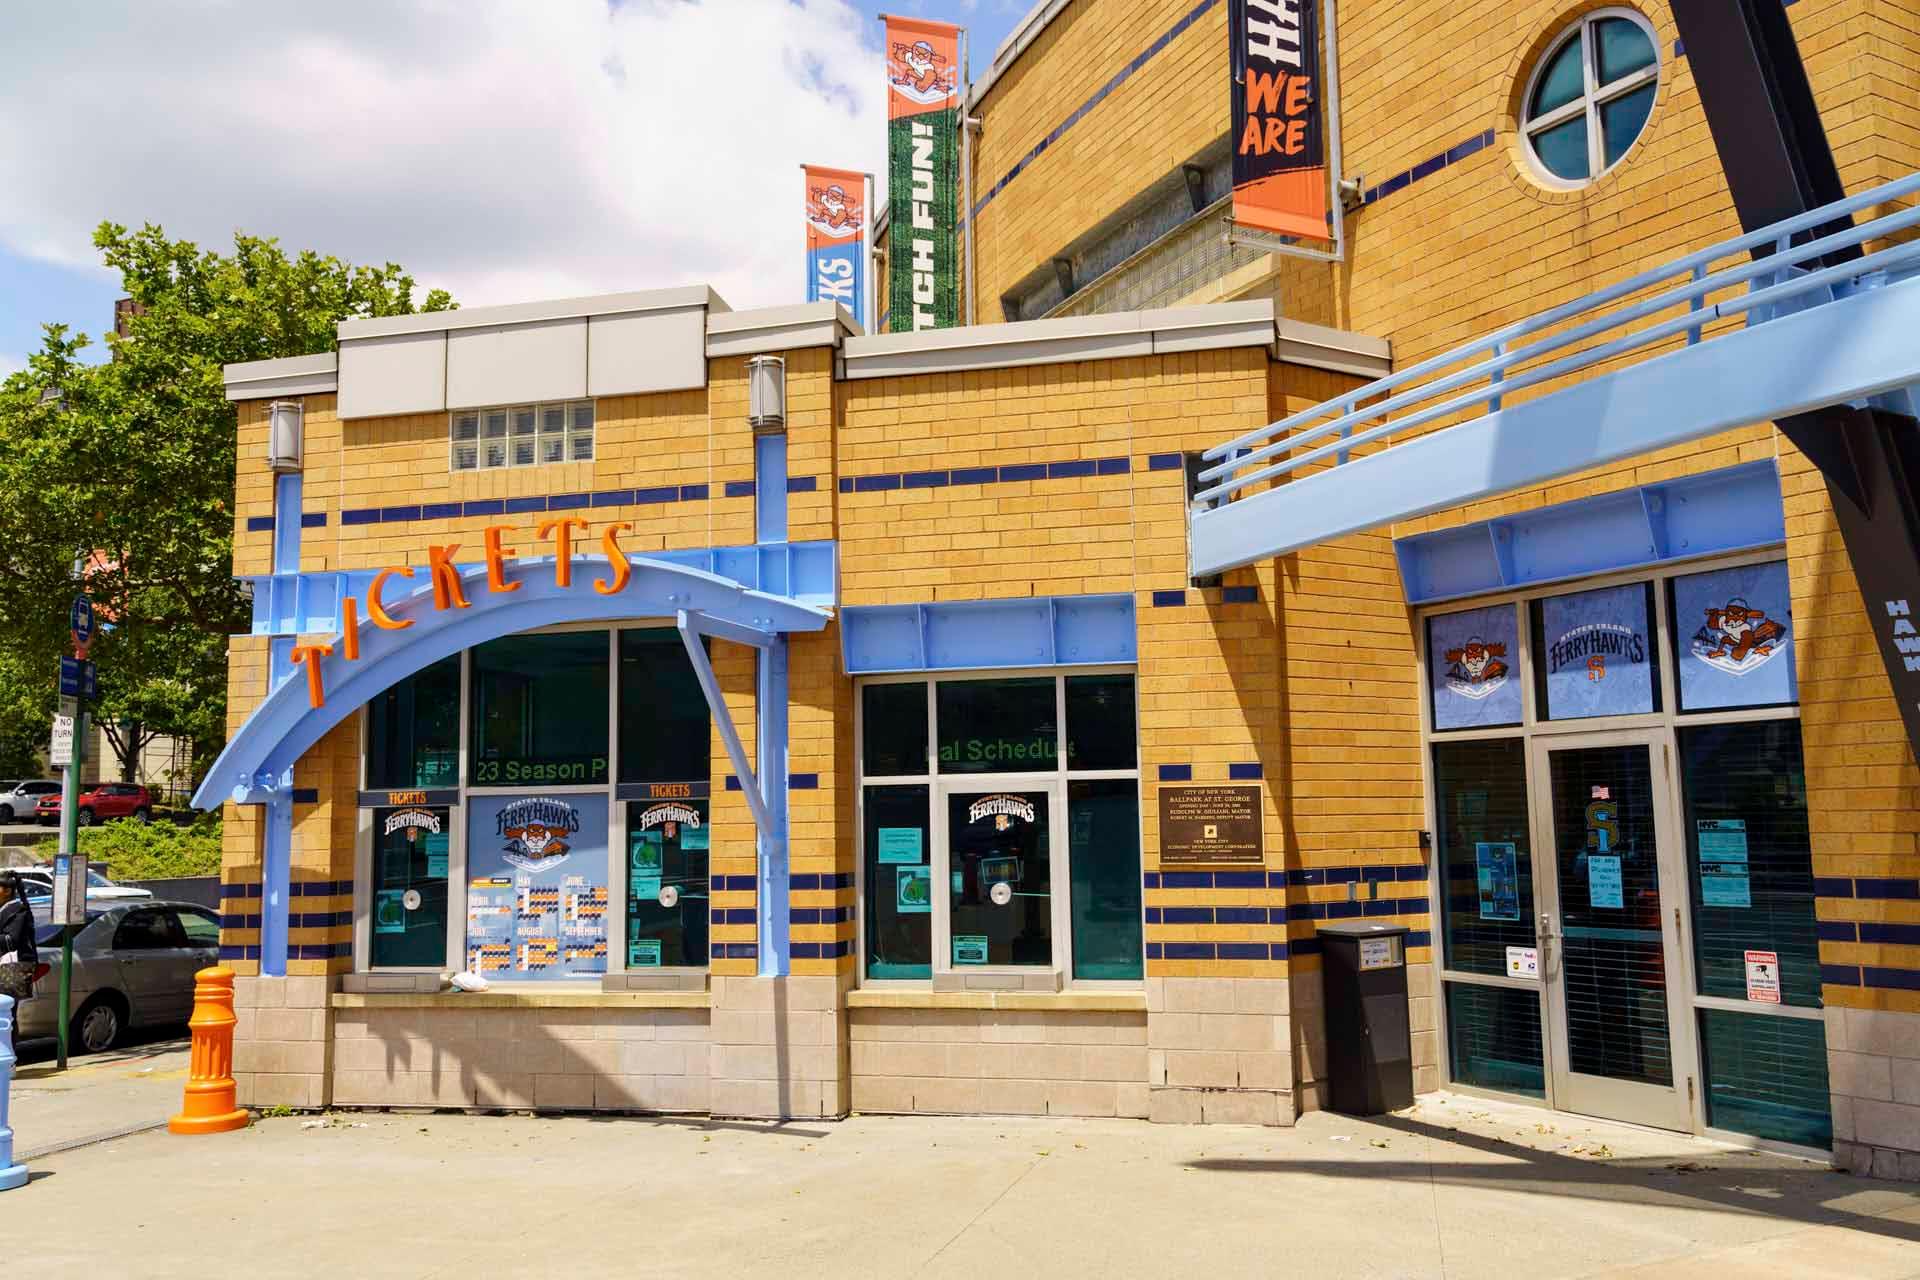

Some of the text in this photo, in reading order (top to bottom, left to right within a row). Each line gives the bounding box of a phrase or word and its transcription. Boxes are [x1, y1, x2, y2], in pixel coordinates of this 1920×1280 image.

[1247, 68, 1310, 116] WE
[1239, 115, 1307, 155] ARE
[911, 122, 934, 230] FUN!
[290, 517, 632, 708] TICKETS
[1550, 629, 1645, 674] FERRYHAWKS
[60, 718, 72, 727] NO
[506, 760, 584, 780] Season
[389, 791, 427, 804] TICKETS
[649, 783, 690, 797] TICKETS
[384, 811, 441, 836] FERRYHAWKS
[496, 802, 580, 836] FERRYHAWKS
[640, 806, 700, 832] FERRYHAWKS
[969, 798, 1035, 824] FERRYHAWKS
